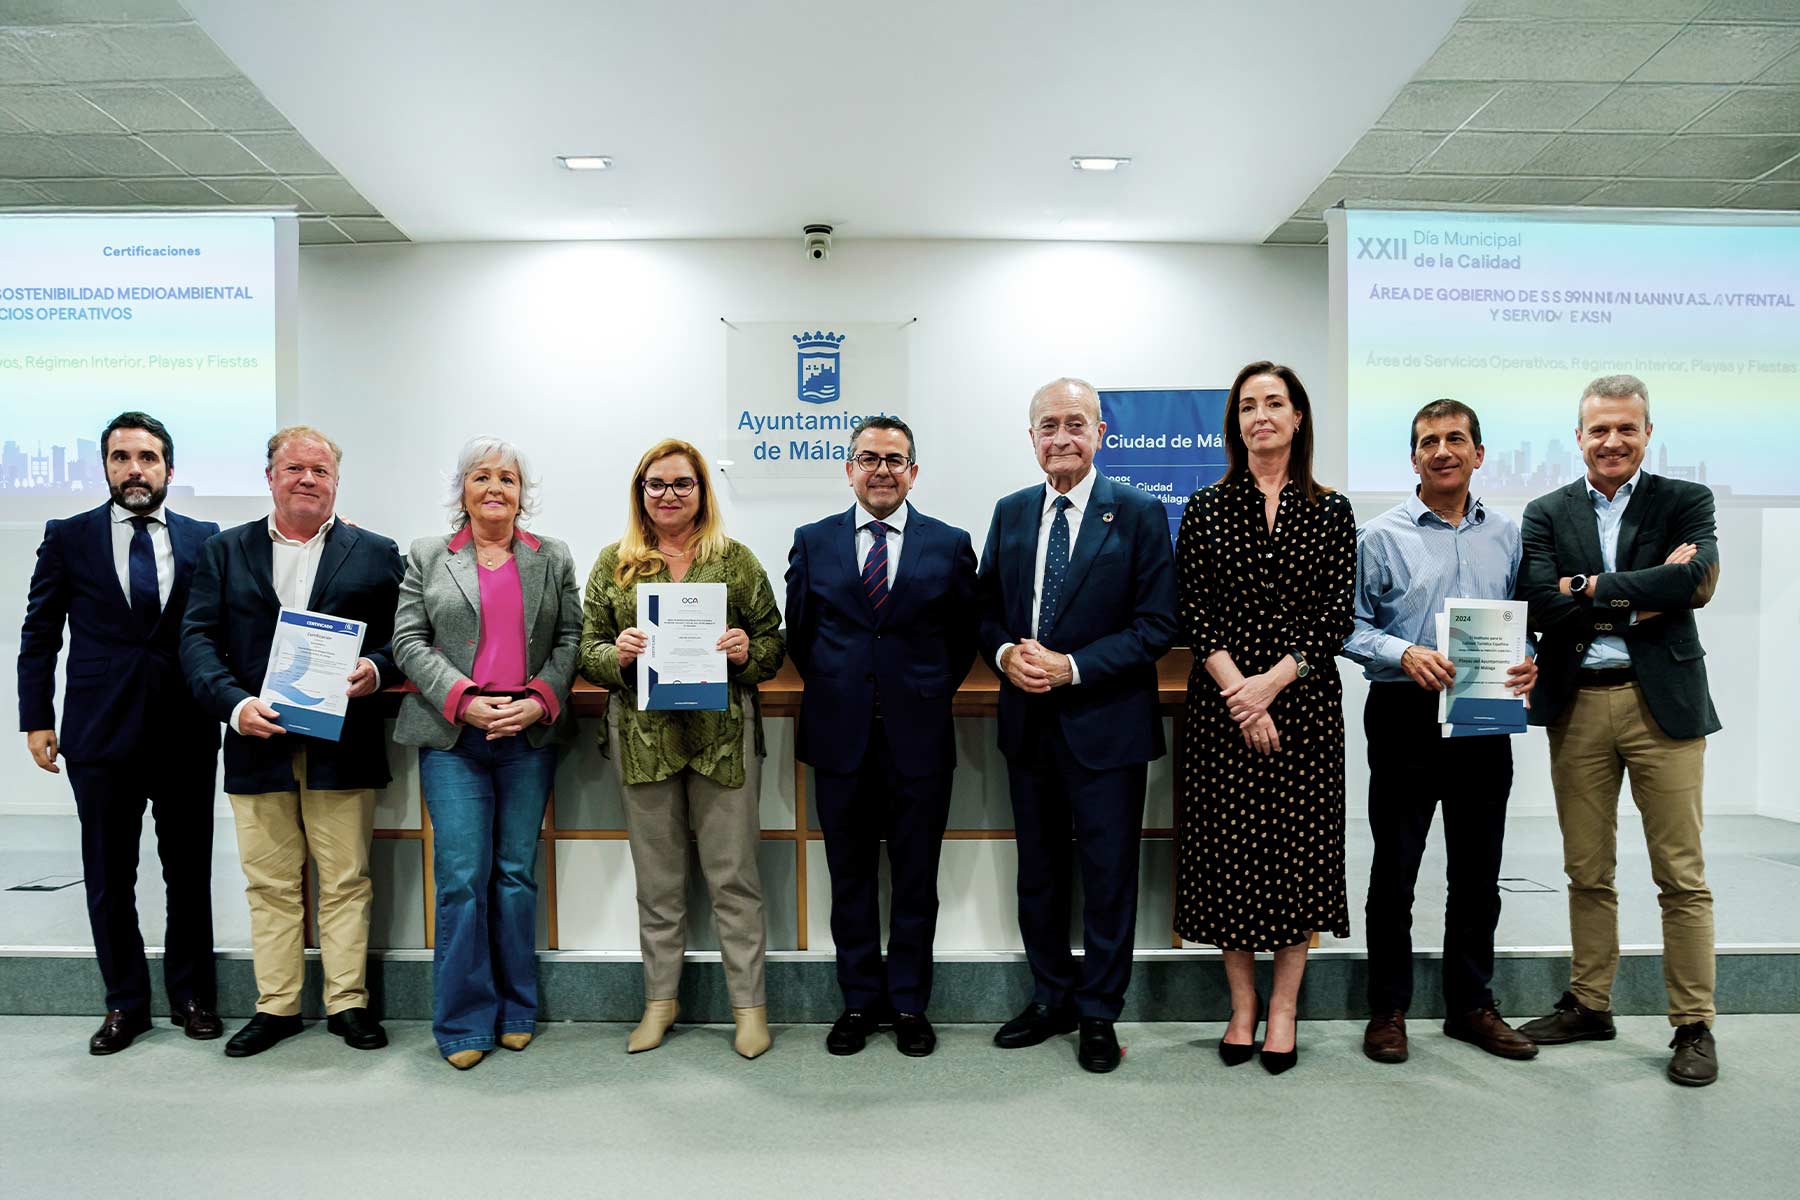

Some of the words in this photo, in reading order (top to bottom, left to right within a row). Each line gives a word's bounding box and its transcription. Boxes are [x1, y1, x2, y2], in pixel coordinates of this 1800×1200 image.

[1414, 230, 1439, 246] Día
[1444, 231, 1521, 250] Municipal
[103, 245, 201, 257] Certificaciones
[1356, 237, 1408, 261] XXII
[1414, 253, 1435, 268] de
[1440, 253, 1454, 269] la
[1457, 254, 1521, 270] Calidad
[0, 287, 115, 301] OSTENIBILIDAD
[117, 286, 254, 300] MEDIOAMBIENTAL
[1369, 283, 1412, 301] ÁREA
[1414, 287, 1434, 302] DE
[1437, 287, 1517, 303] GOBIERNO
[1518, 289, 1538, 304] DE
[36, 306, 133, 321] OPERATIVOS
[1489, 308, 1501, 321] Y
[25, 354, 89, 372] Régimen
[148, 354, 193, 371] Playas
[196, 358, 204, 371] y
[208, 354, 259, 369] Fiestas
[1366, 349, 1400, 368] Área
[1403, 353, 1421, 368] de
[1423, 354, 1488, 369] Servicios
[738, 411, 901, 434] Ayuntamie
[1106, 434, 1166, 449] Ciudad
[1171, 433, 1192, 448] de
[753, 441, 781, 461] de
[789, 440, 853, 461] Mála
[1136, 482, 1173, 492] Ciudad
[306, 620, 333, 630] CERTIFICADO
